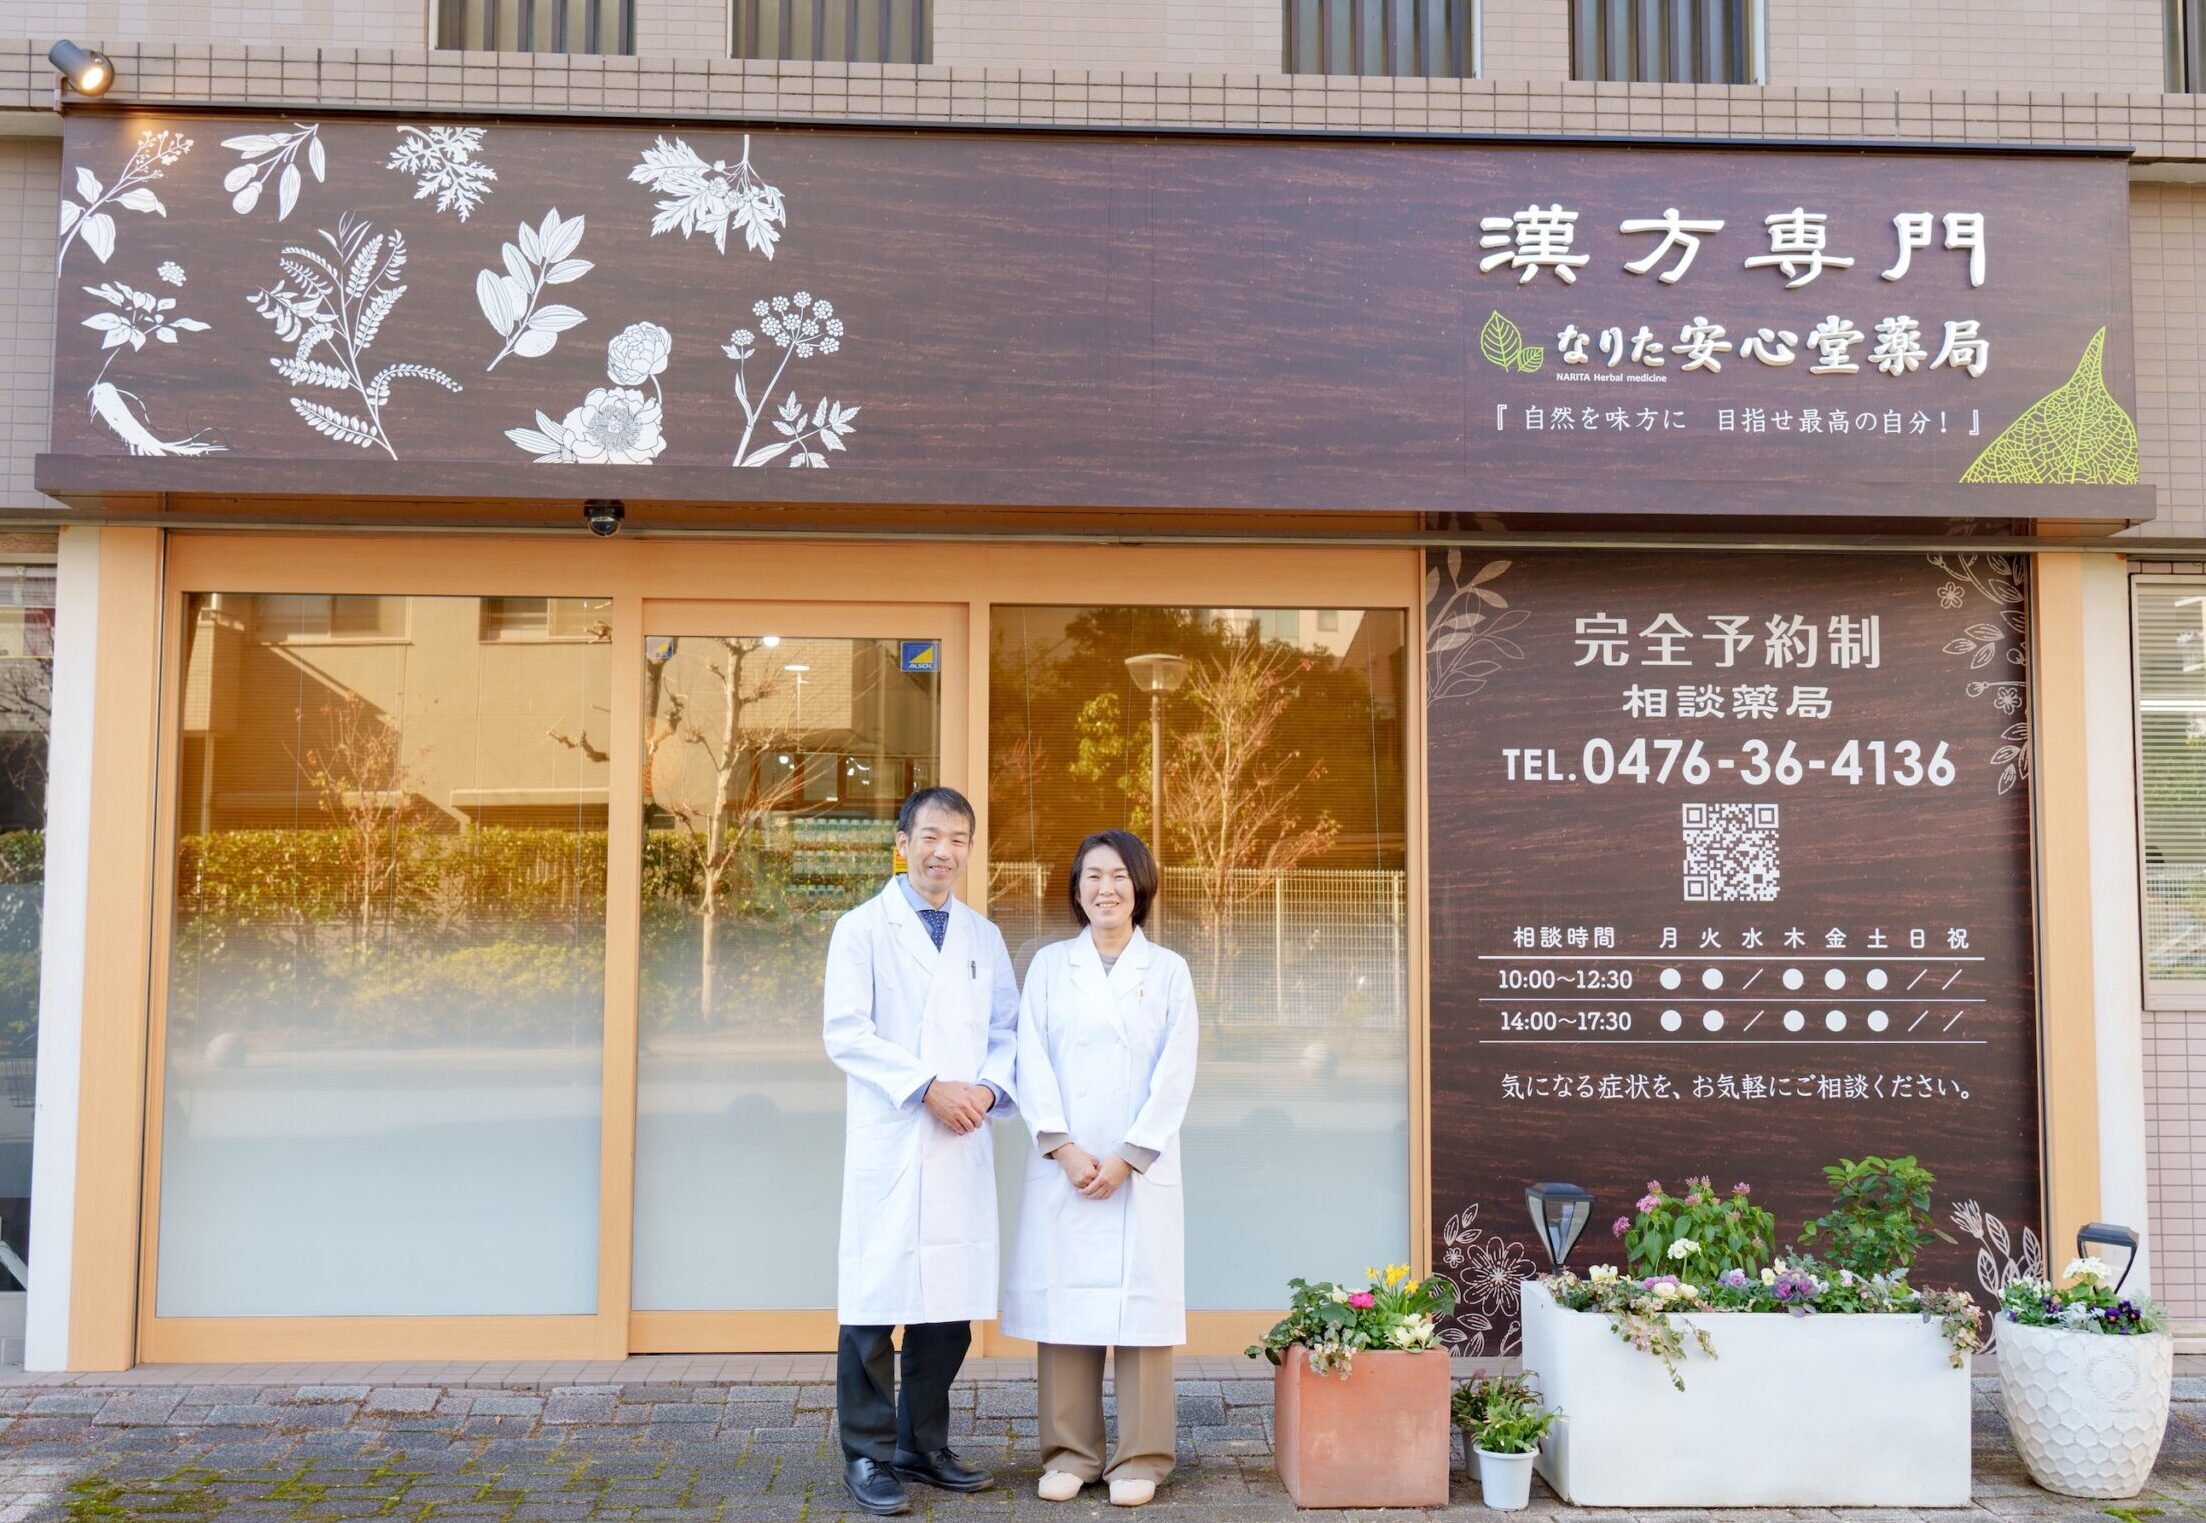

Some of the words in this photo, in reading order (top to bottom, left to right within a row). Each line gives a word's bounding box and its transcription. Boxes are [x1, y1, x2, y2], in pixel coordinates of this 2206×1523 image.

[1479, 203, 1987, 289] 漢方専門
[1556, 314, 1991, 379] なりた安心堂薬局
[1556, 373, 1590, 382] NARITA
[1593, 373, 1624, 382] Herbal
[1626, 374, 1668, 382] medicine
[1574, 612, 1881, 669] 完全予約制
[1622, 683, 1833, 720] 相談薬局
[1512, 926, 1615, 949] 相談時間
[1659, 928, 1677, 948] 月
[1699, 927, 1722, 949] 火
[1741, 928, 1764, 949] 水
[1783, 928, 1806, 949] 木
[1824, 927, 1848, 949] 金
[1866, 928, 1889, 949] 土
[1909, 929, 1926, 949] 日
[1946, 928, 1970, 950] 祝
